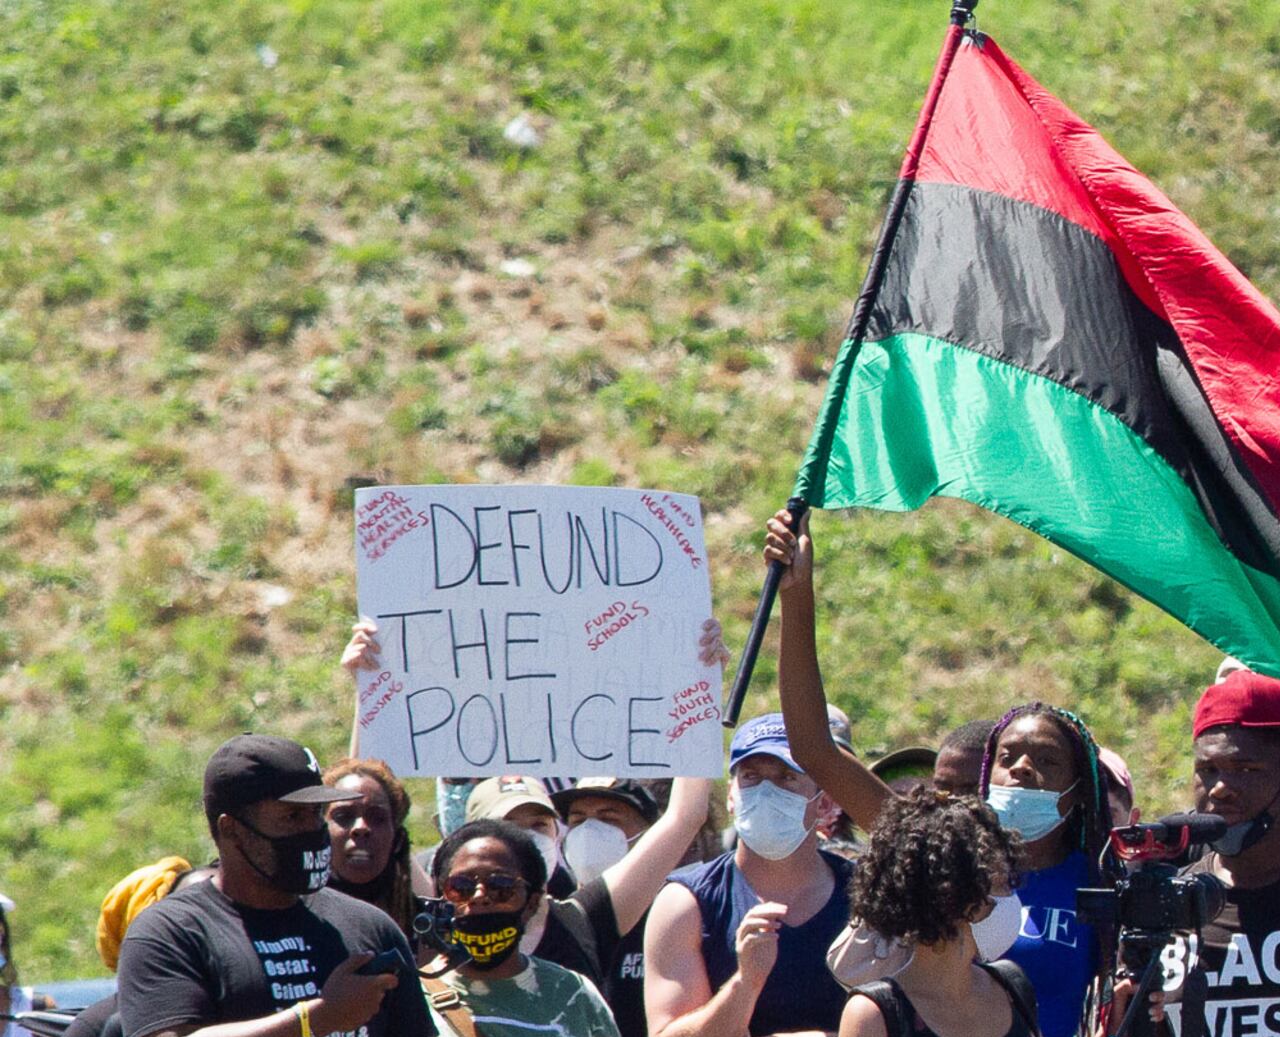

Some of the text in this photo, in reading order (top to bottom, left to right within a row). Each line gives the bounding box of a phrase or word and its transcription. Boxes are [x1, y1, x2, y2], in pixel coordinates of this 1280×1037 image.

[430, 503, 664, 594] DEFUND
[584, 600, 627, 634] FUND
[587, 601, 649, 652] SCHOOLS
[377, 608, 557, 681] THE
[669, 693, 714, 720] YOUTH
[673, 680, 711, 703] FUND
[406, 686, 671, 770] POLICE
